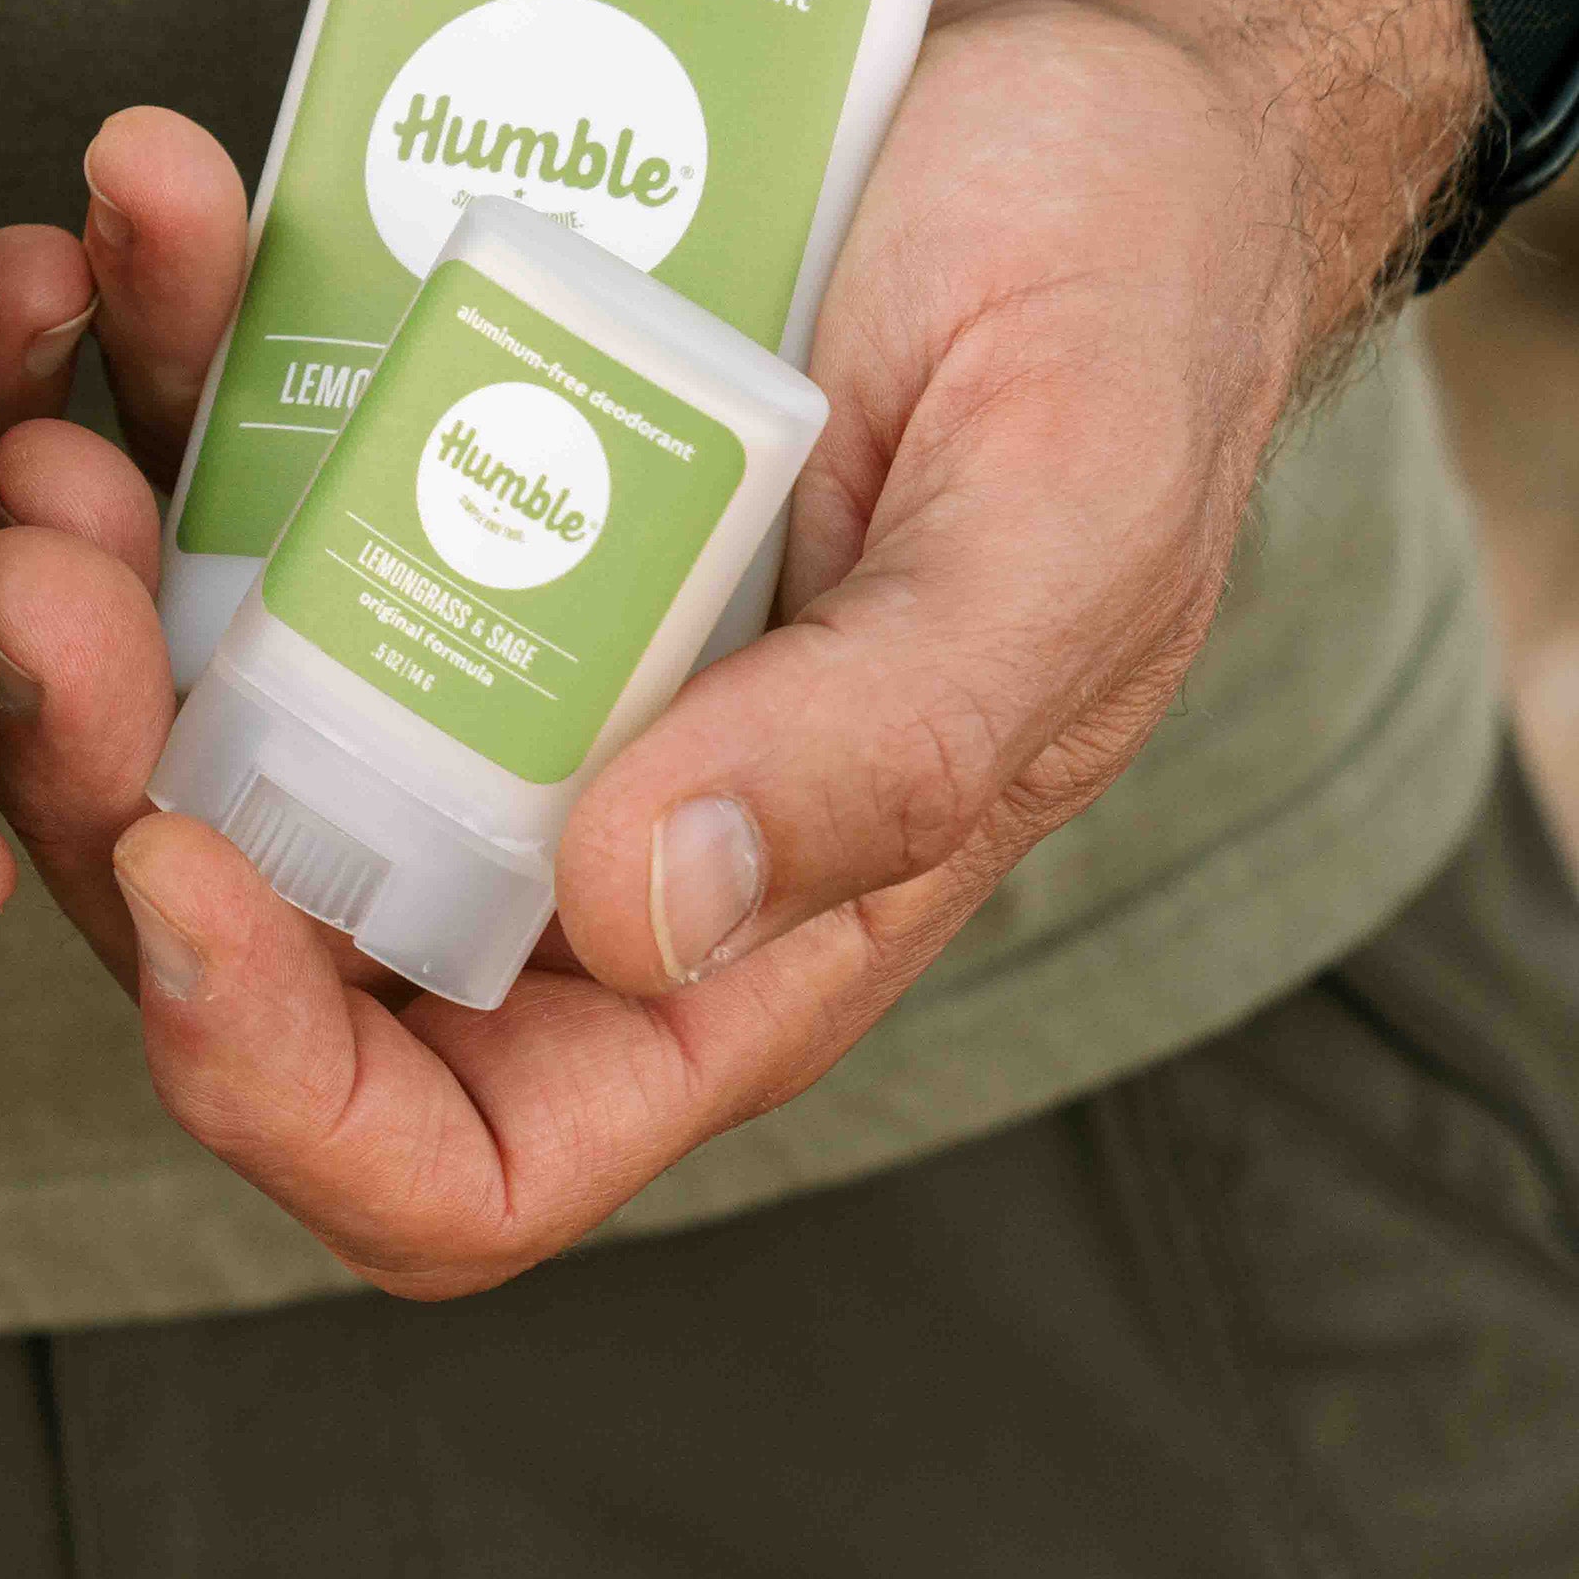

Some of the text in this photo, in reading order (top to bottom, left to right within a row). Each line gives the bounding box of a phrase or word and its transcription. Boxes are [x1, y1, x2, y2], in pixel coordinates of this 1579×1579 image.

[457, 303, 698, 462] aluminum-free deodorant
[357, 539, 540, 670] LEMONGRASS & SAGE
[359, 590, 496, 687] original formula
